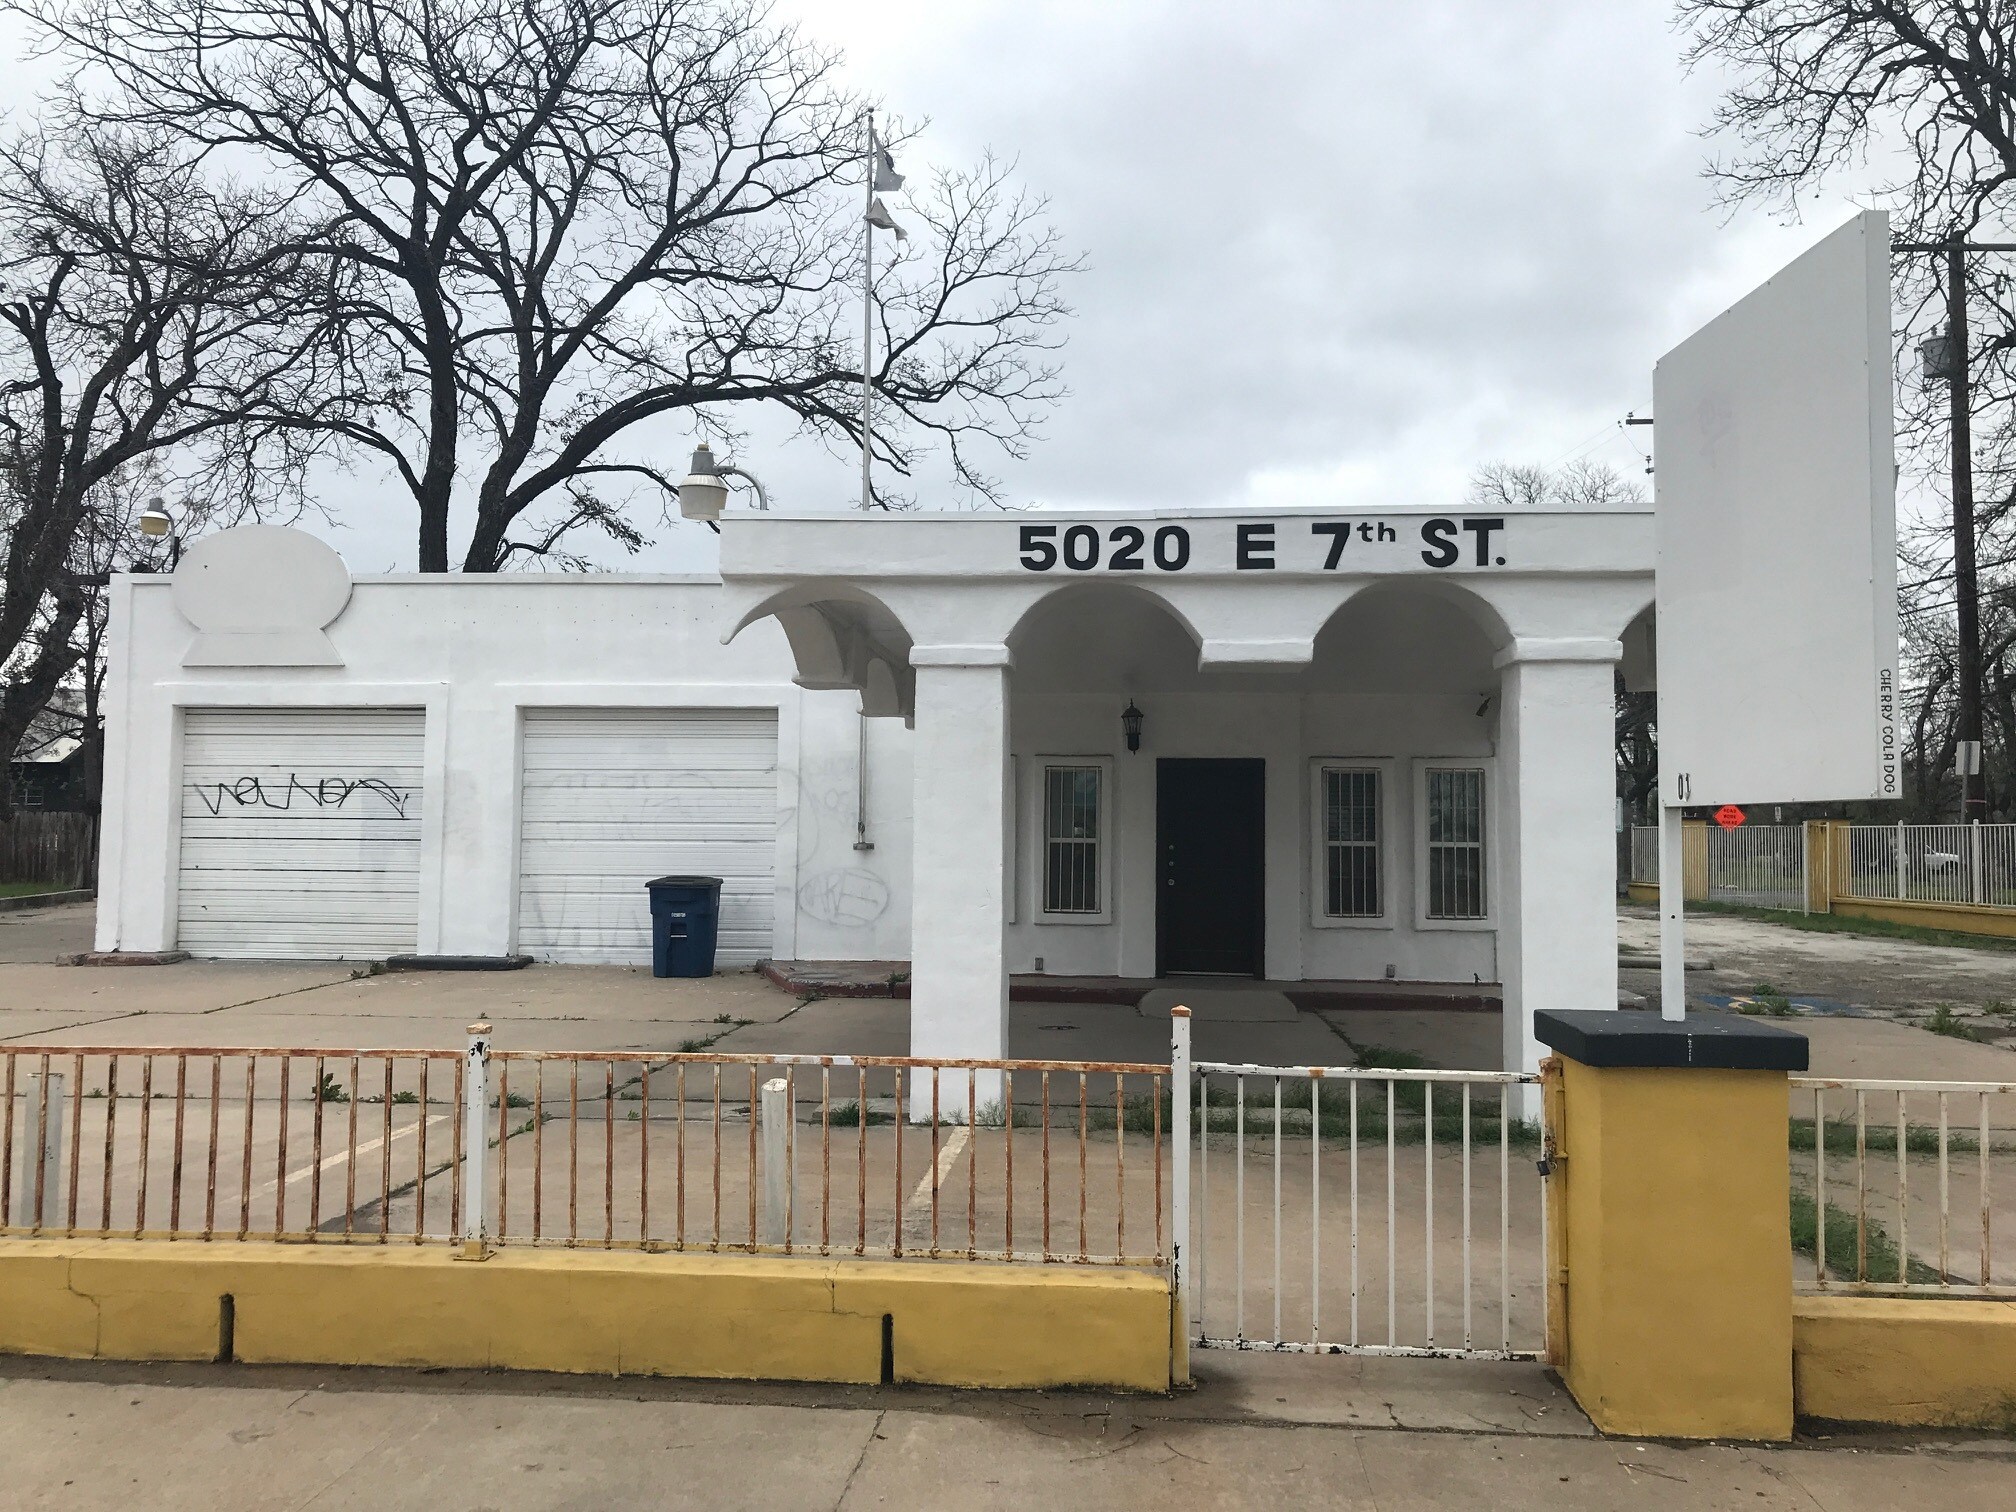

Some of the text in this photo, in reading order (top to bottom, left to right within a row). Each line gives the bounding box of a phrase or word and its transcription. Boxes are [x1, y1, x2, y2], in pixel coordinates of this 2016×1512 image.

[1019, 518, 1506, 571] 5020 E 7th ST.
[1880, 668, 1896, 793] CHERRY COLA DOG
